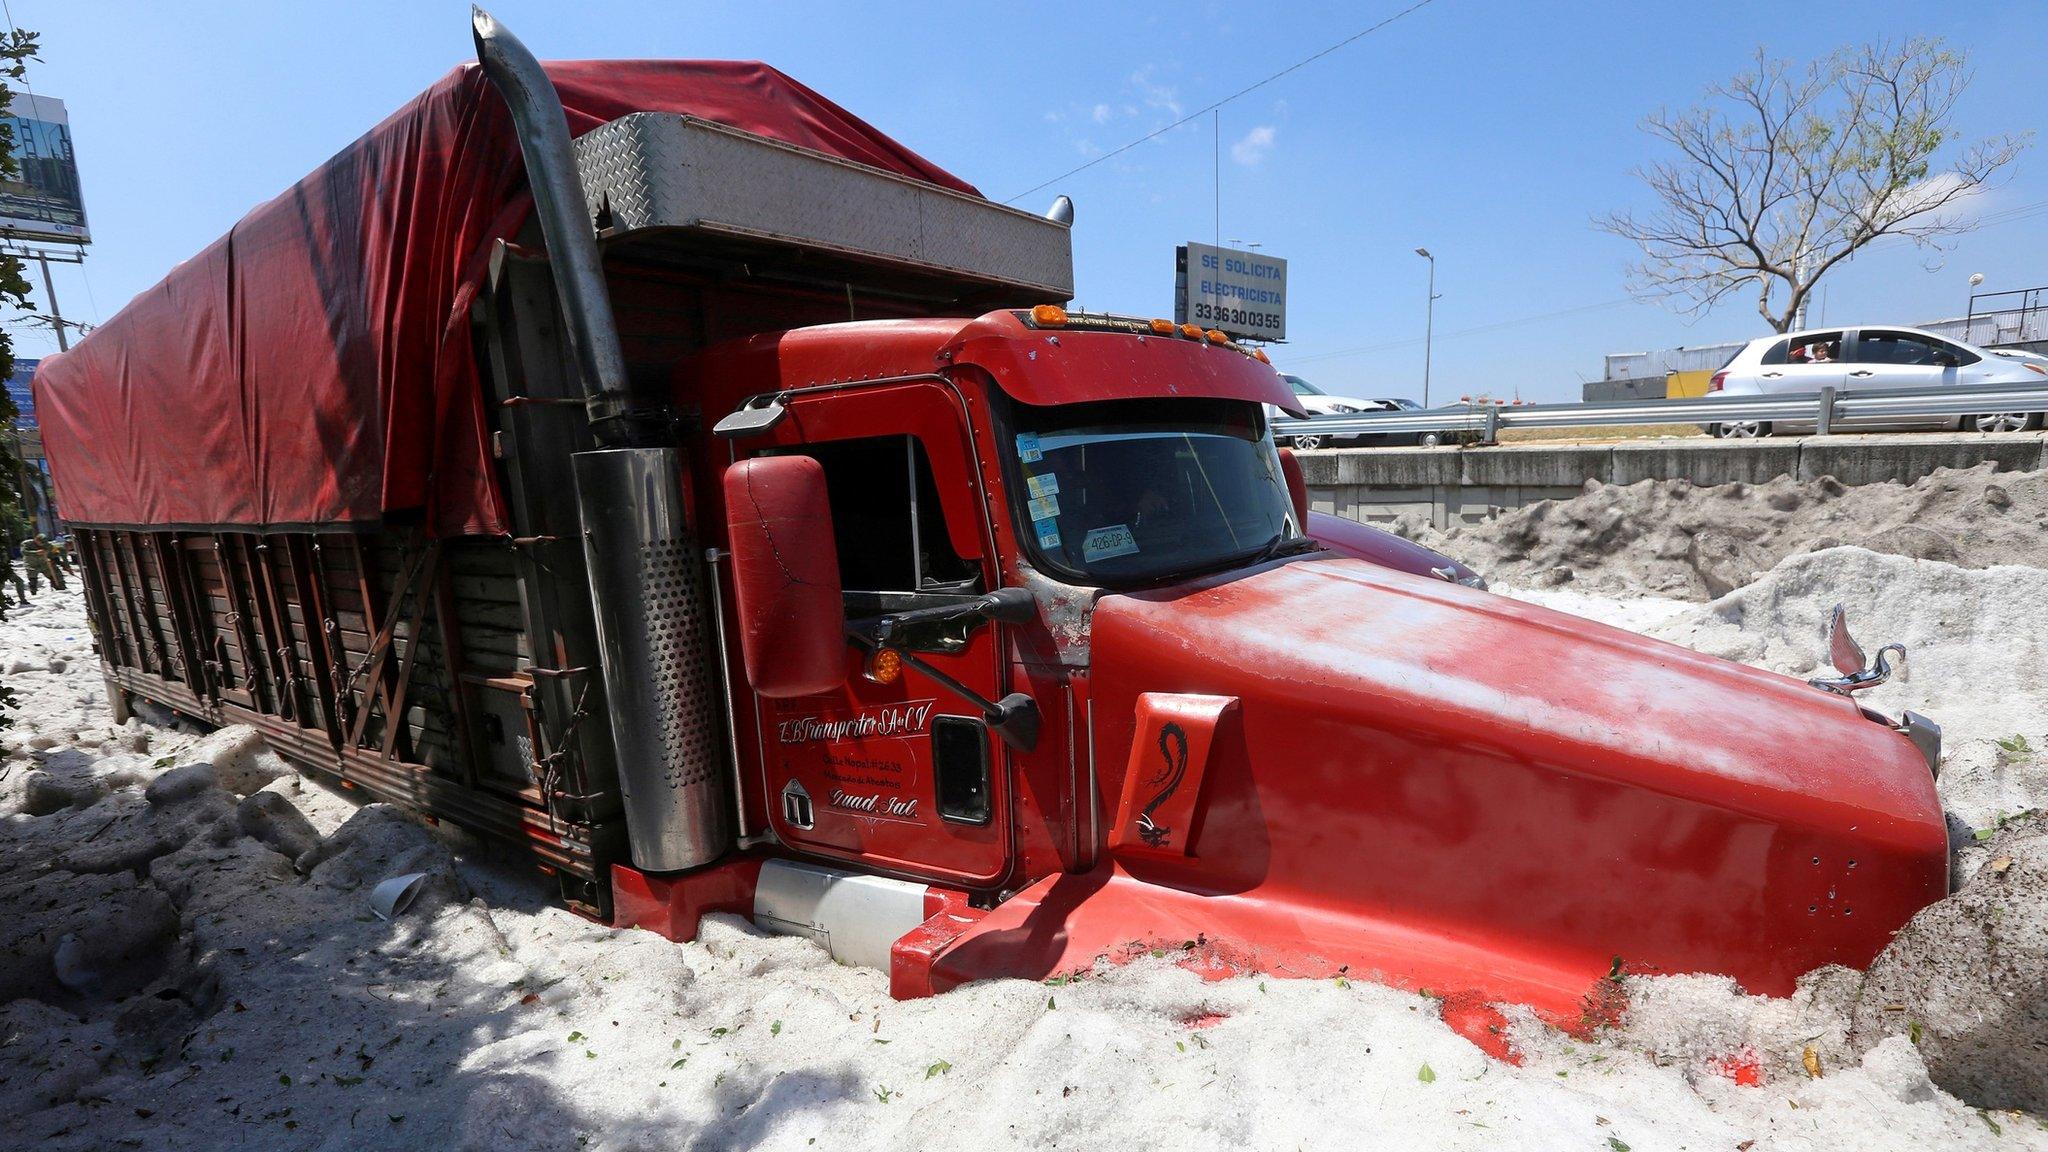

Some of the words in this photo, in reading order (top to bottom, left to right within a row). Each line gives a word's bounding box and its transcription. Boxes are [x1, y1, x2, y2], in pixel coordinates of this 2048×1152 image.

[1202, 254, 1218, 269] SE
[1225, 258, 1280, 280] SOLICITA
[1201, 280, 1282, 305] ELECTRICISTA
